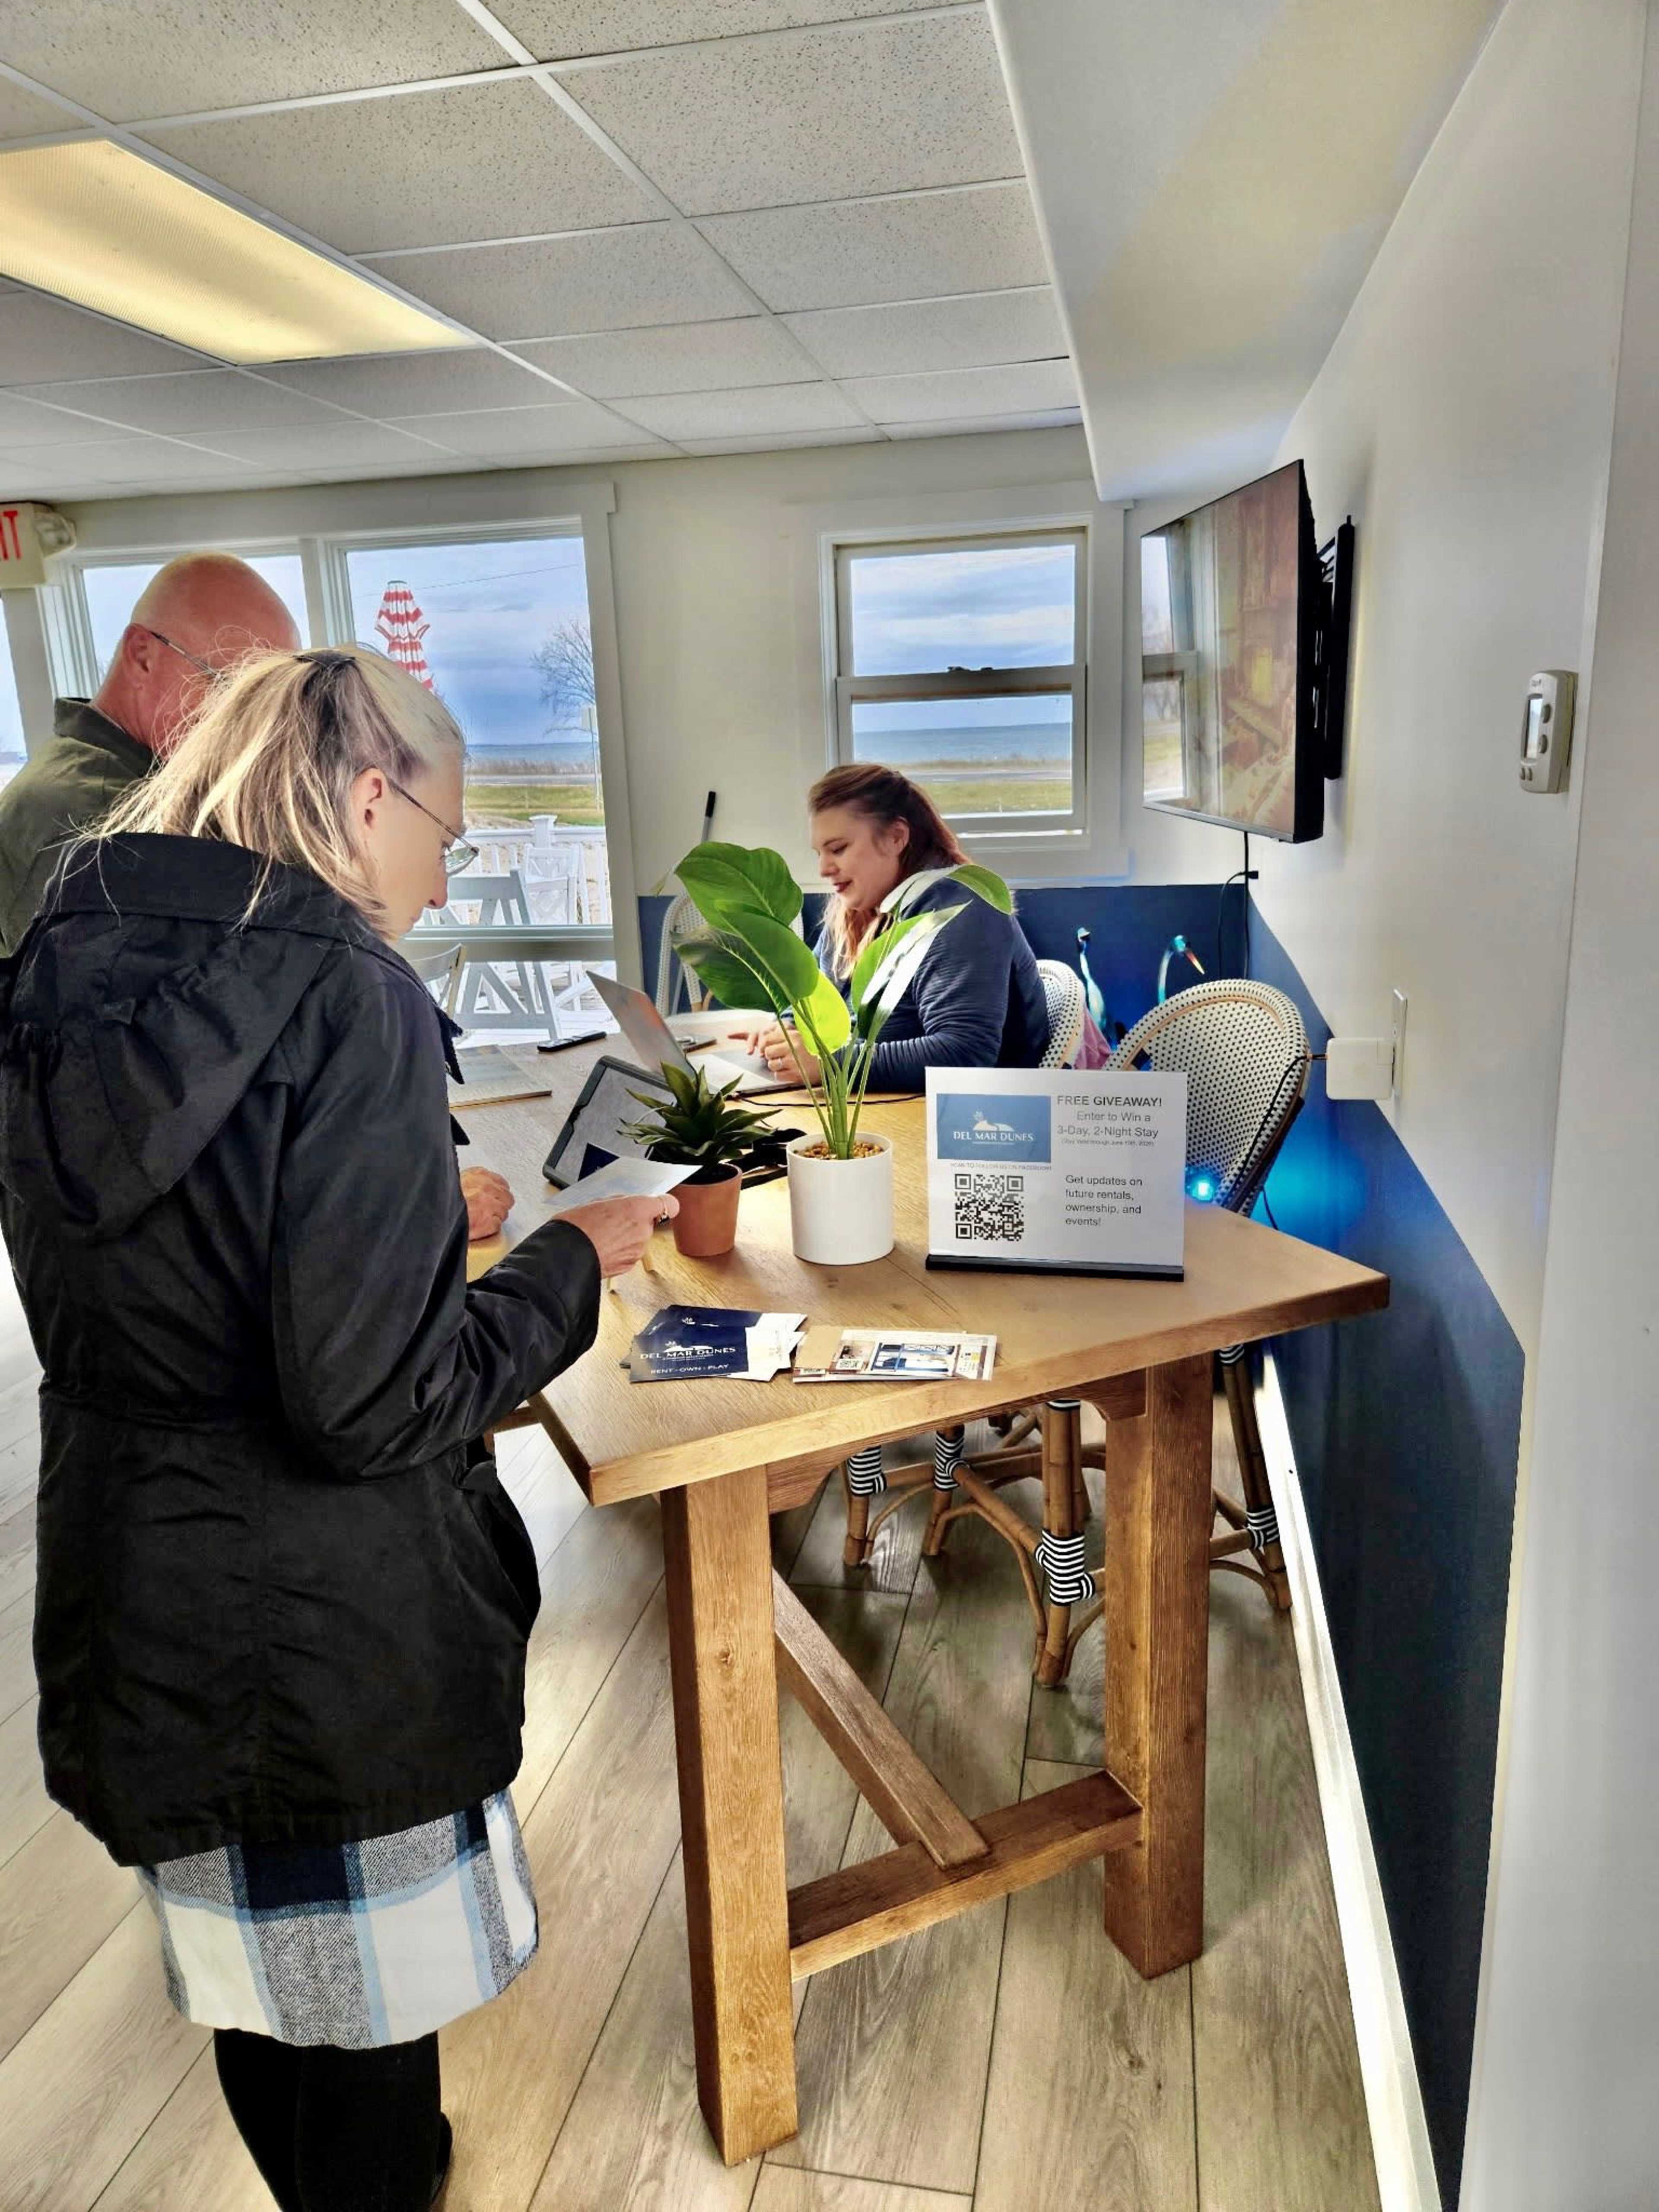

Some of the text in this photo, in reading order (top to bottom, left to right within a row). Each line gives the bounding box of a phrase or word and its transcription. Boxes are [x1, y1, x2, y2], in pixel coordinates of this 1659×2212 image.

[1057, 1096, 1162, 1106] FREE GIVEAWAY!
[1077, 1111, 1104, 1121] Enter
[1107, 1112, 1117, 1121] to
[1121, 1112, 1141, 1122] Win
[953, 1131, 1034, 1141] DEL MAR DUNES
[1057, 1125, 1158, 1139] 3-Day, 2-Night Stay
[1065, 1175, 1084, 1184] Get
[1087, 1176, 1126, 1186] updates
[1065, 1189, 1134, 1201] future rentals,
[1065, 1204, 1141, 1214] ownership, and
[1065, 1217, 1101, 1226] events!
